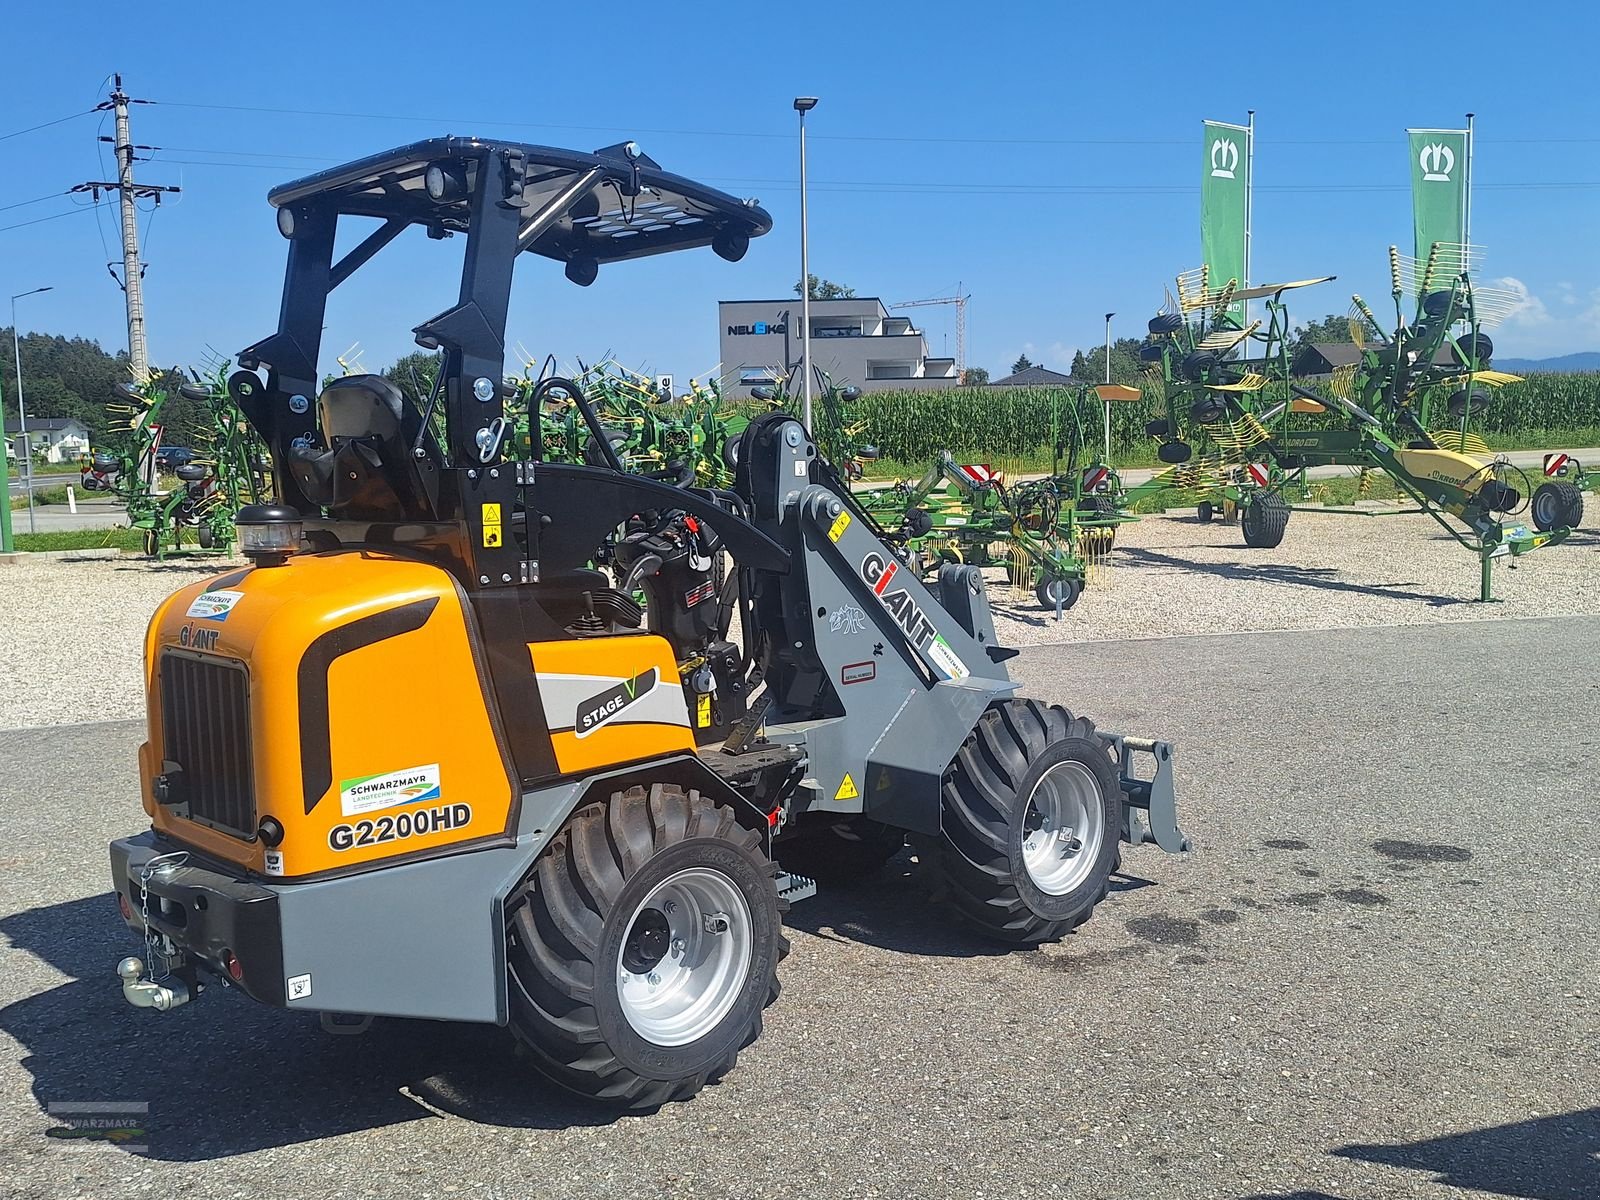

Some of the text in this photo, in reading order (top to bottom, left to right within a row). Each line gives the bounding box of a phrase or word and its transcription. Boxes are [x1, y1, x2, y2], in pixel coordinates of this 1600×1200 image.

[582, 695, 624, 727] STAGE
[350, 775, 426, 796] SCHWARZMAYR
[352, 790, 397, 803] LANDTECHNIK
[328, 803, 472, 852] G2200HD
